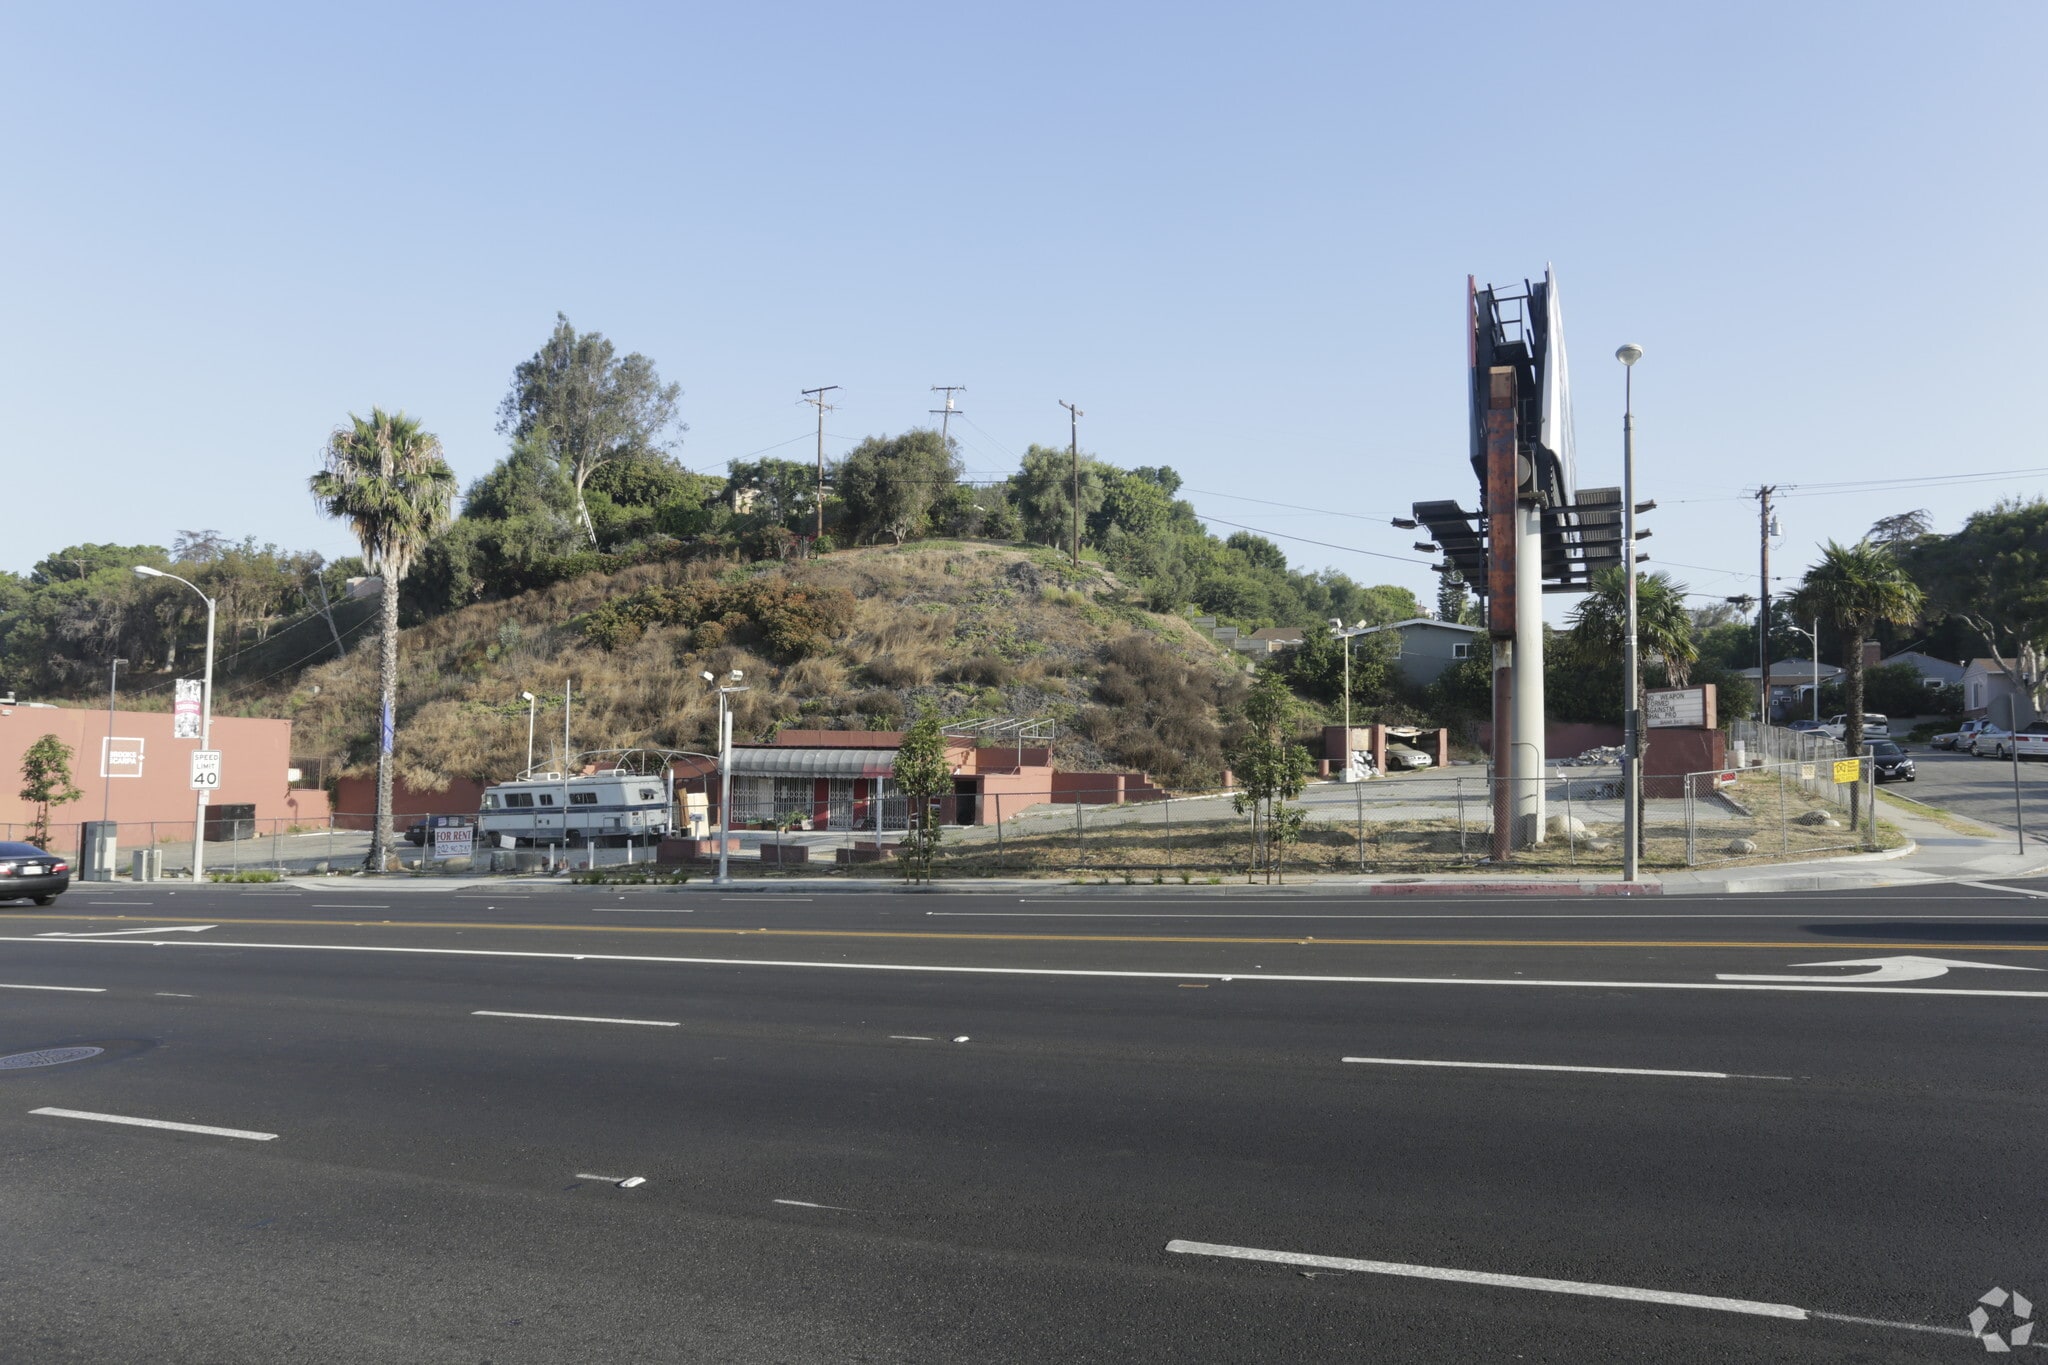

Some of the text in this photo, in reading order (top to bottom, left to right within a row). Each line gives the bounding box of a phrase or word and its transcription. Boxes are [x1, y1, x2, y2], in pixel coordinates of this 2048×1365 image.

[194, 772, 217, 785] 40
[437, 830, 471, 841] FOR RENT
